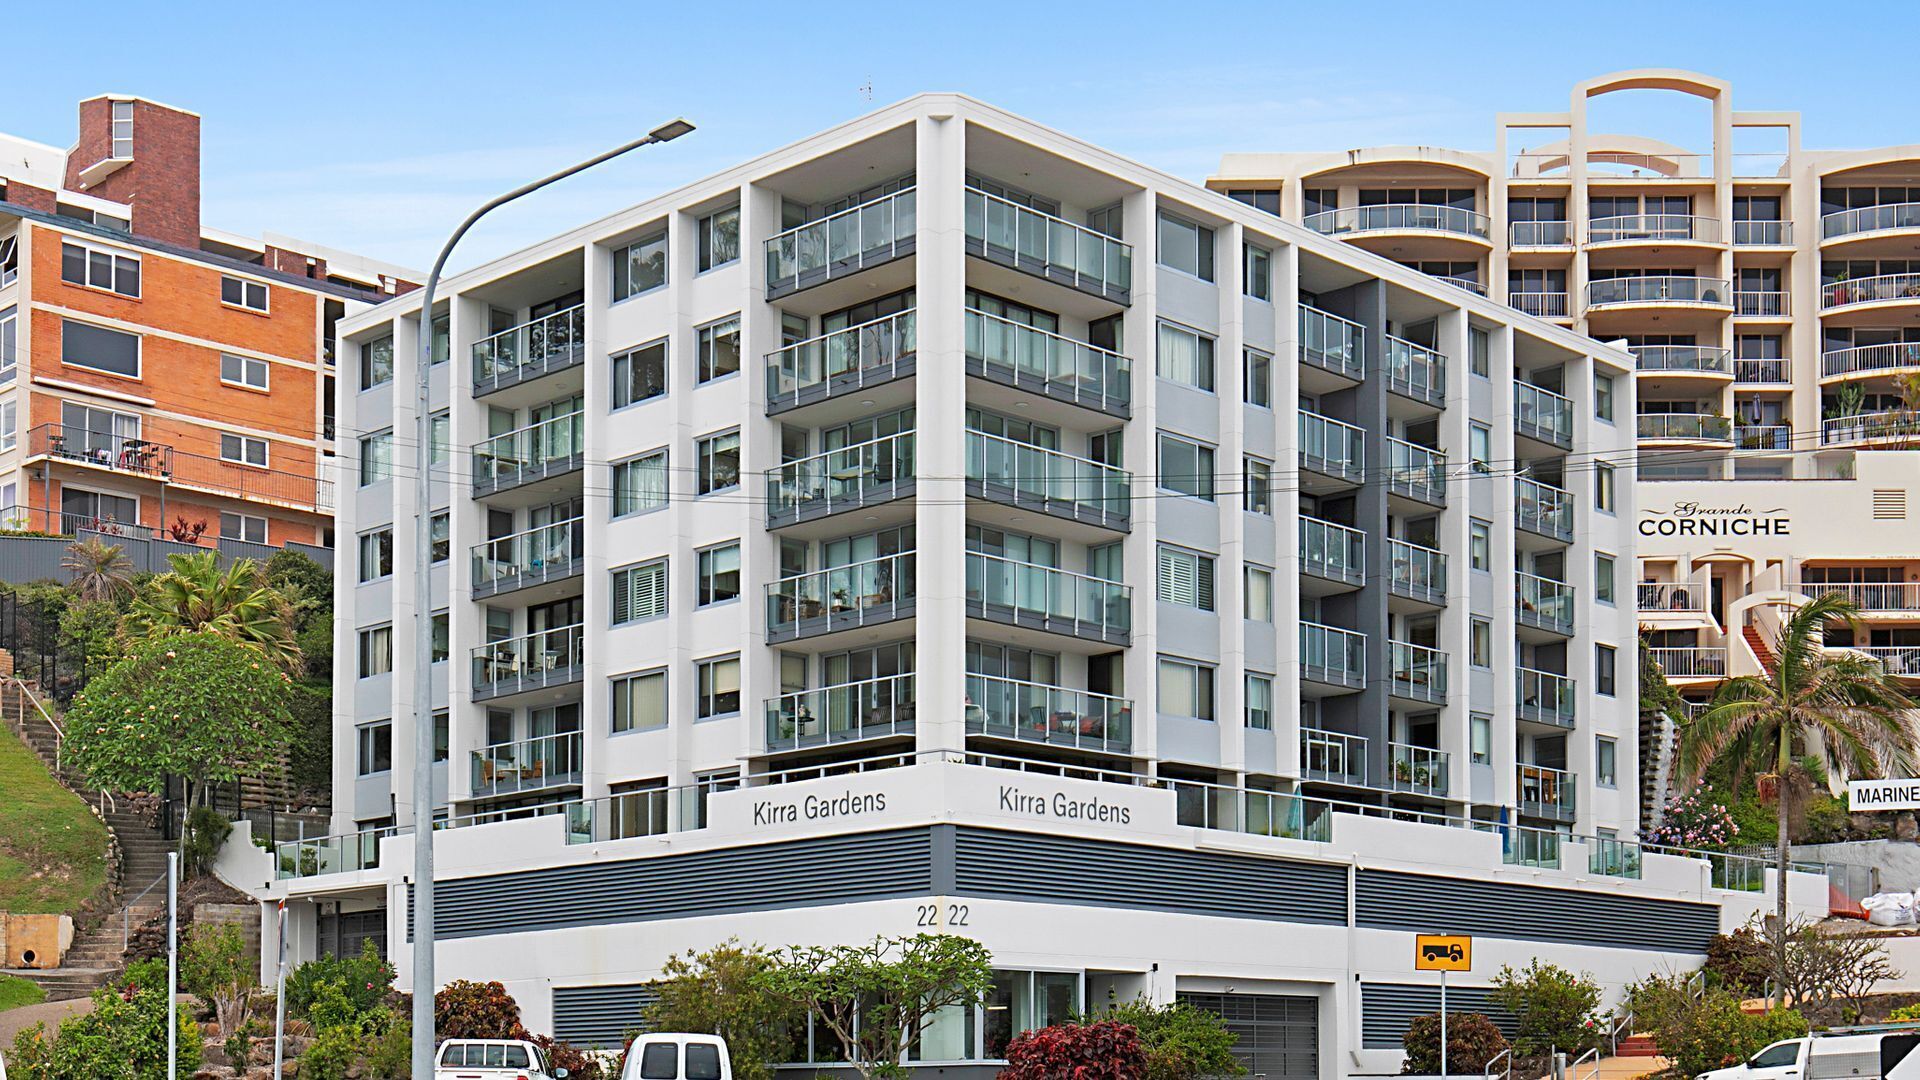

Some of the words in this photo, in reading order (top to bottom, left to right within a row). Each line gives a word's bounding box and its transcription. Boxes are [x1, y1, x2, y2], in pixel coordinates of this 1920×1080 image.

[1673, 501, 1752, 517] Grande
[1638, 518, 1790, 536] CORNICHE
[1000, 785, 1046, 815] Kirra
[1053, 792, 1131, 825] Gardens
[1857, 786, 1920, 804] MARINE
[753, 801, 797, 826] Kirra
[804, 790, 886, 820] Gardens
[917, 904, 938, 926] 22
[948, 904, 969, 926] 22
